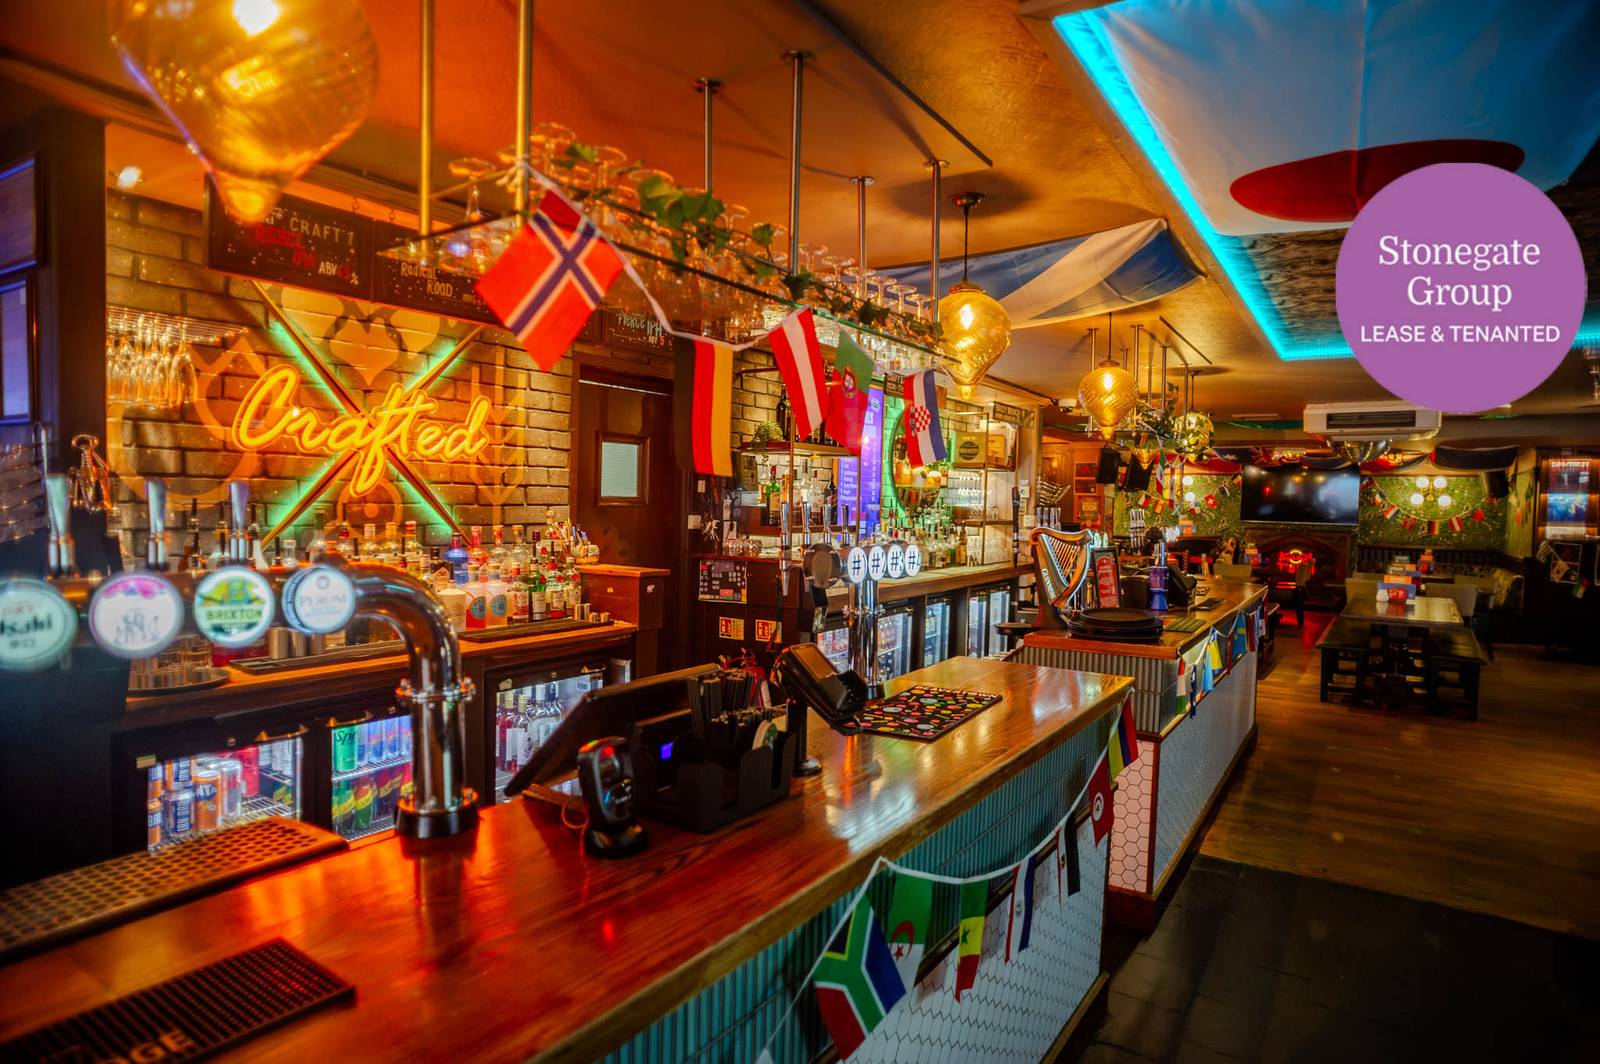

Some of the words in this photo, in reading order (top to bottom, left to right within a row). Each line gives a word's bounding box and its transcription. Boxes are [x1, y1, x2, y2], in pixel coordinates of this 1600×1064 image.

[289, 217, 341, 242] CRAFT
[318, 261, 338, 276] ABV
[235, 366, 489, 494] Crafted
[206, 608, 262, 621] BRIXTON
